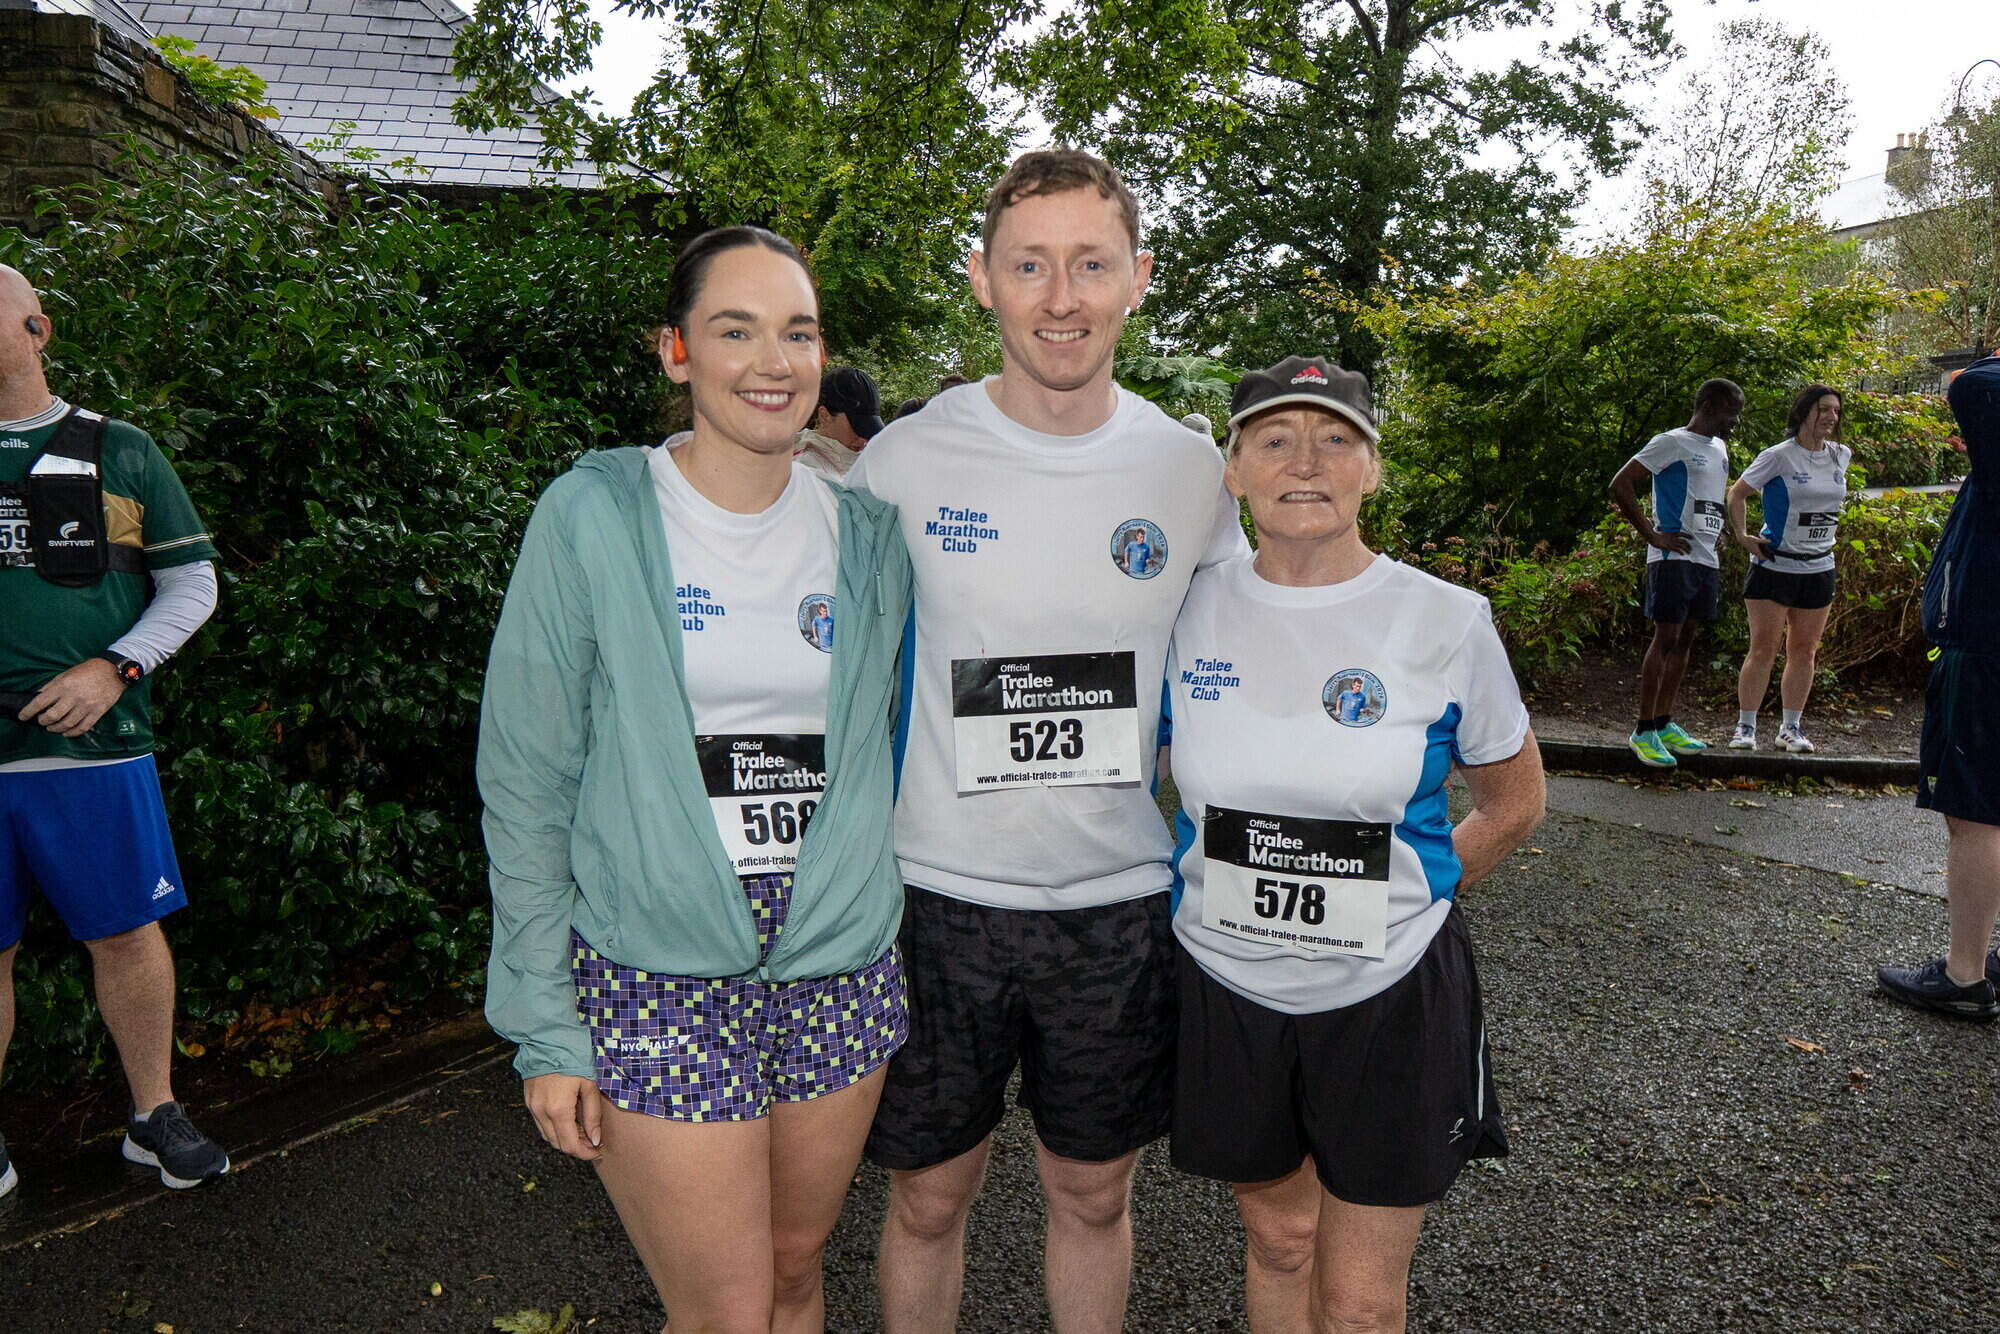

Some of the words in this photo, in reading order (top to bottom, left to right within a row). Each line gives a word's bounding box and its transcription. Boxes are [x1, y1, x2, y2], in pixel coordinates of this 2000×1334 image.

[1291, 374, 1328, 385] adidas
[0, 438, 30, 449] eills
[0, 496, 22, 506] lee
[938, 506, 988, 524] Tralee
[925, 521, 999, 540] Marathon
[1808, 527, 1829, 539] 1672
[942, 537, 977, 554] Club
[676, 584, 711, 599] alee
[677, 600, 725, 616] athon
[682, 616, 704, 631] ub
[1000, 663, 1030, 673] Official
[1195, 658, 1233, 672] Tralee
[998, 673, 1054, 690] Tralee
[1181, 671, 1240, 687] Marathon
[1002, 686, 1113, 709] Marathon
[1191, 687, 1220, 701] Club
[732, 741, 763, 751] Official
[1009, 718, 1084, 763] 523
[730, 752, 785, 769] Tralee
[733, 767, 826, 791] Maratho
[1249, 819, 1280, 831] Official
[1246, 829, 1303, 850] Tralee
[738, 855, 798, 868] official-tralee-
[1248, 845, 1364, 874] Marathon
[1254, 877, 1326, 926] 578
